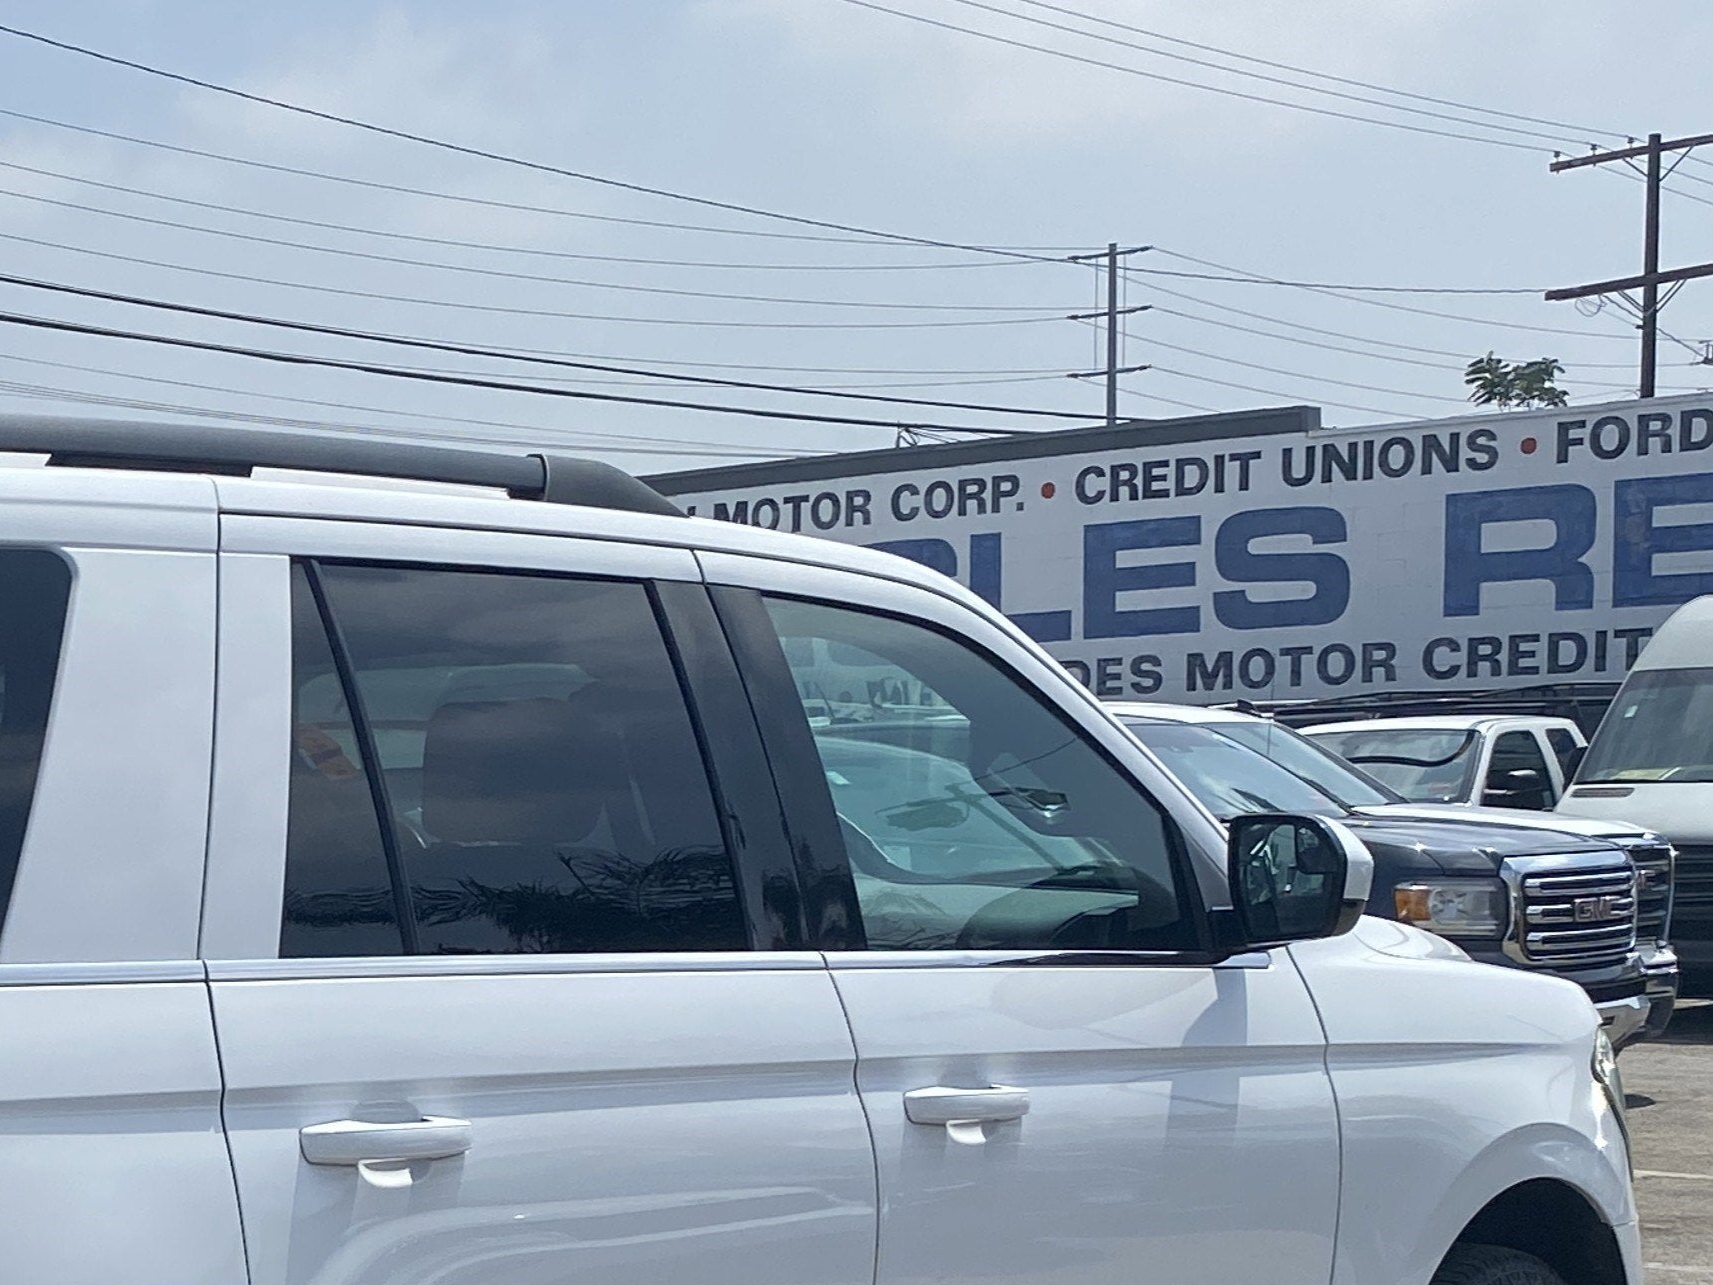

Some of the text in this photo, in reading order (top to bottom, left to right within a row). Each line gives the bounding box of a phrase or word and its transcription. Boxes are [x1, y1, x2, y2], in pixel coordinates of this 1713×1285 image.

[890, 474, 1025, 523] CORP.
[1074, 450, 1262, 506] CREDIT
[1281, 428, 1499, 489] UNIONS
[1556, 408, 1713, 465] FORD
[1185, 641, 1397, 693] MOTOR
[1422, 627, 1653, 681] CREDIT
